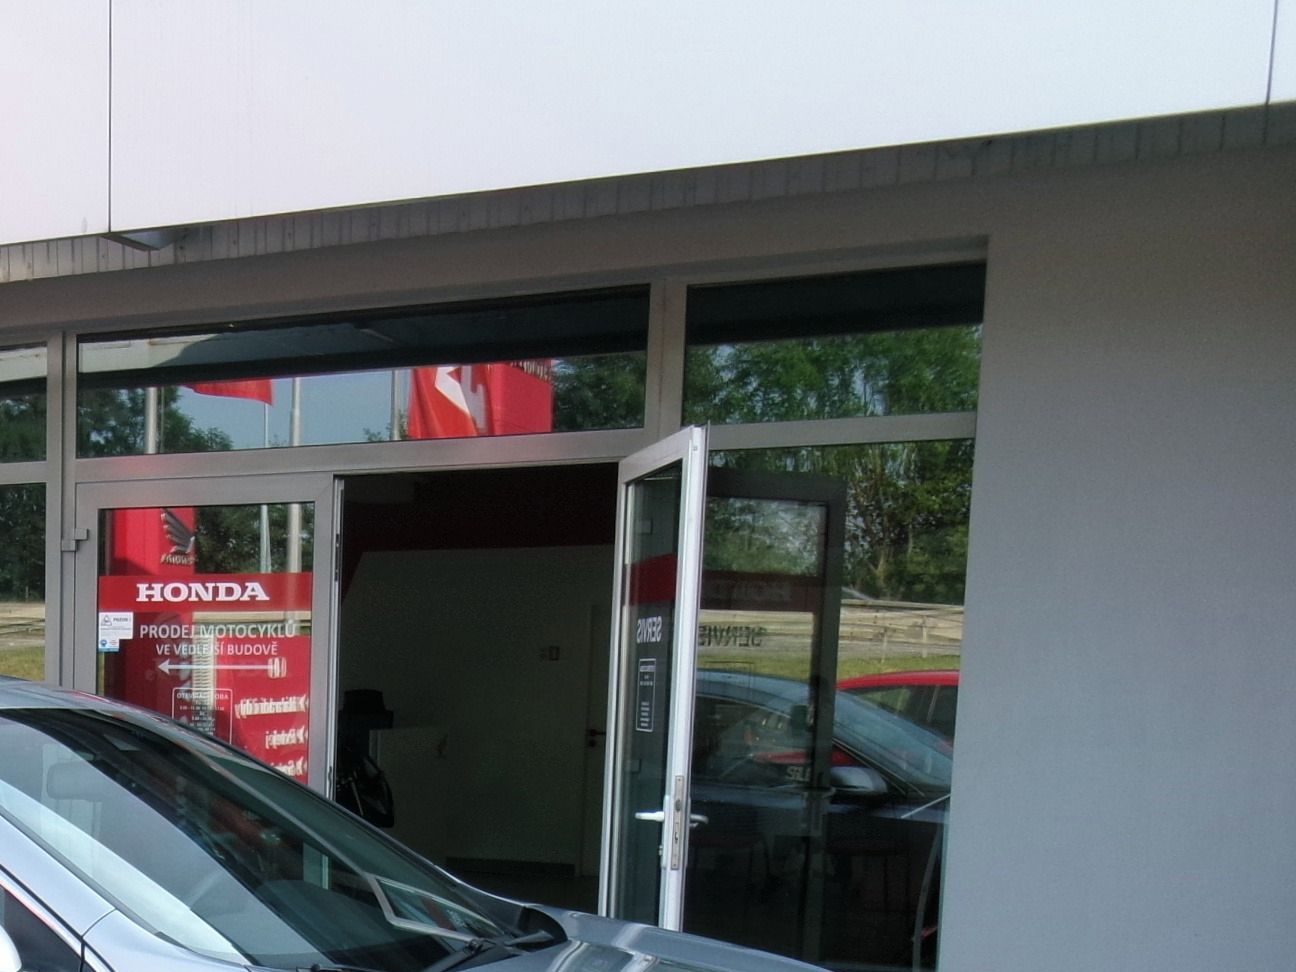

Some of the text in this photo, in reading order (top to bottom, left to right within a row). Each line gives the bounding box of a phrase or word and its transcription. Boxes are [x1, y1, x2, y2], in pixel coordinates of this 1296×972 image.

[136, 582, 270, 602] HONDA
[199, 619, 296, 638] MOTOCYKLŮ
[156, 644, 171, 656] VE
[227, 641, 278, 656] BUDOVĚ
